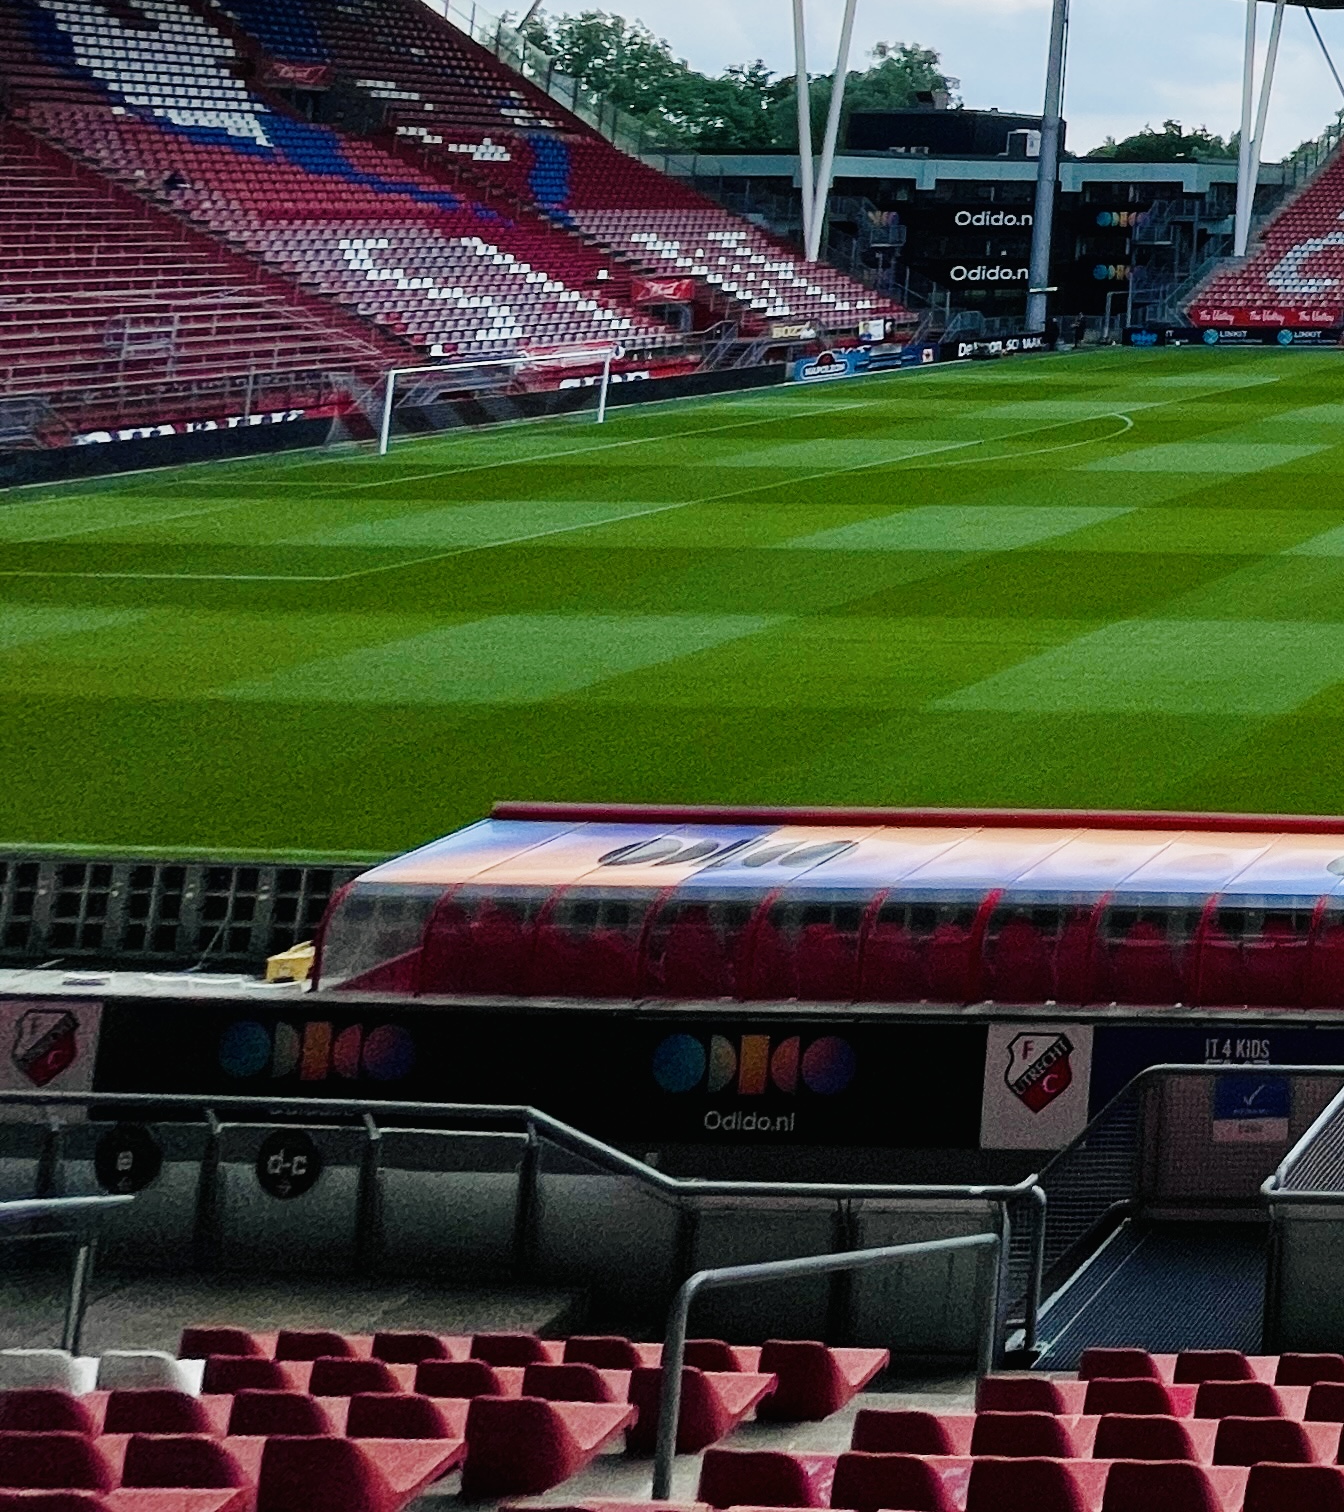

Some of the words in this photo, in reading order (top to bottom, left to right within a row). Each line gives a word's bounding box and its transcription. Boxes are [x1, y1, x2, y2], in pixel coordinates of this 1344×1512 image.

[954, 210, 1034, 226] Odido.n
[949, 265, 1029, 281] Odido.n
[1205, 1039, 1218, 1058] IT
[1221, 1039, 1232, 1057] 4
[1235, 1039, 1271, 1058] KIDS
[704, 1110, 796, 1132] Odido.nl
